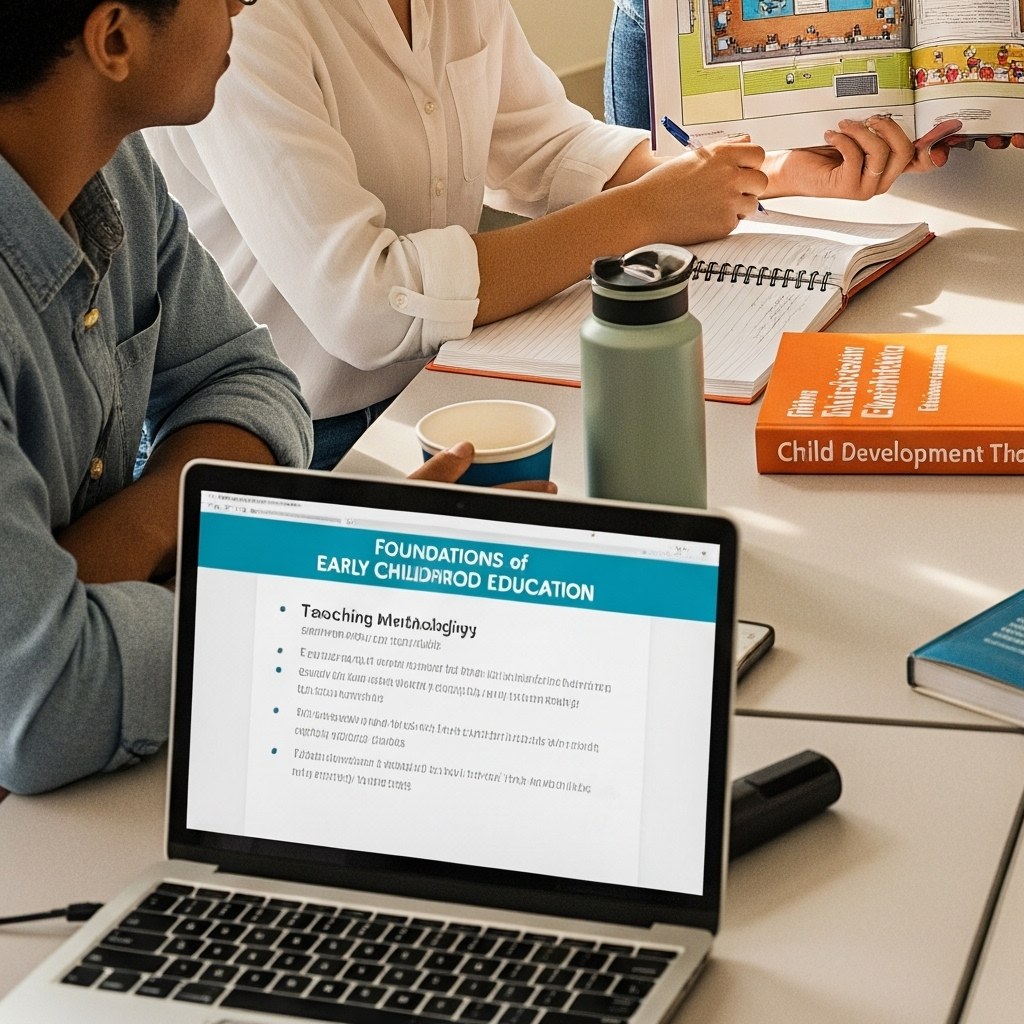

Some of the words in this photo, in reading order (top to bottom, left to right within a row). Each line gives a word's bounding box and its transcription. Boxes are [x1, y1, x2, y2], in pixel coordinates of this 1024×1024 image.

[777, 439, 834, 463] Child
[842, 440, 985, 470] Development
[374, 538, 504, 569] FOUNDATIONS
[510, 553, 530, 572] of
[316, 554, 370, 577] EARLY
[487, 574, 595, 602] EDUCATION
